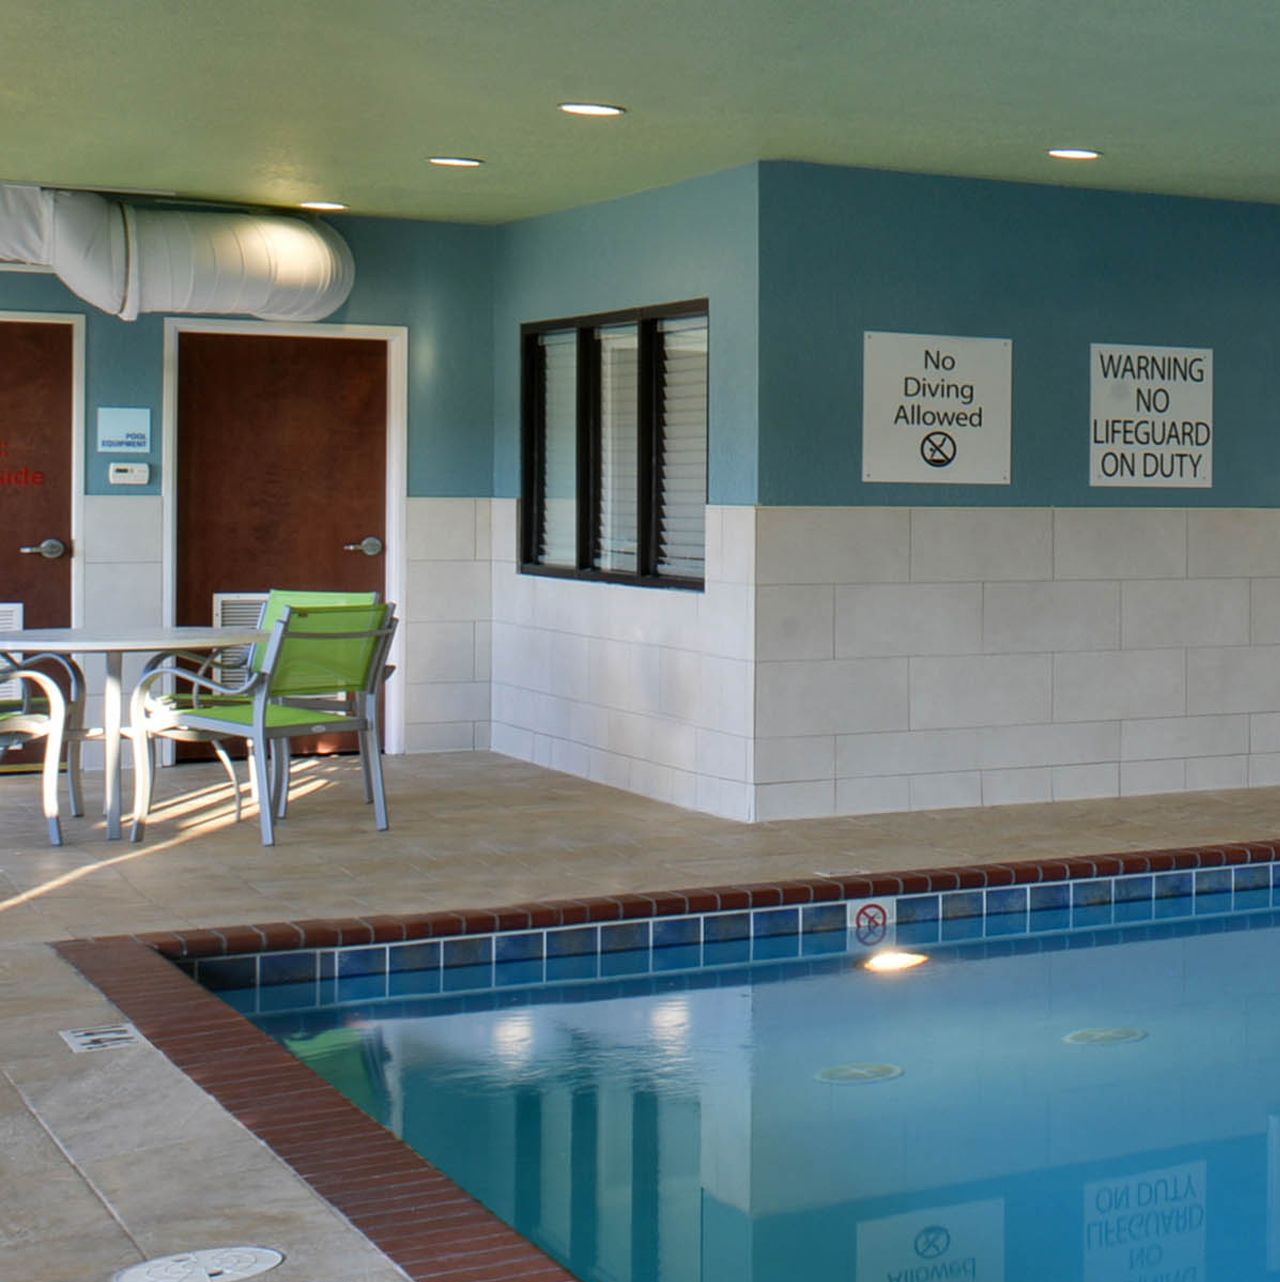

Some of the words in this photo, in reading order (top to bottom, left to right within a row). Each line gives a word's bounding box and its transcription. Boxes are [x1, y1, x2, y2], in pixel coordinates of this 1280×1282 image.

[924, 349, 956, 372] No
[1099, 353, 1205, 383] WARNING
[903, 376, 974, 404] Diving
[1136, 387, 1170, 414] NO
[893, 404, 983, 428] Allowed
[101, 439, 147, 448] EQUIPMENT
[125, 432, 146, 440] POOL
[1093, 419, 1211, 447] LIFEGUARD
[1100, 452, 1136, 478] ON
[1142, 453, 1203, 479] DUTY
